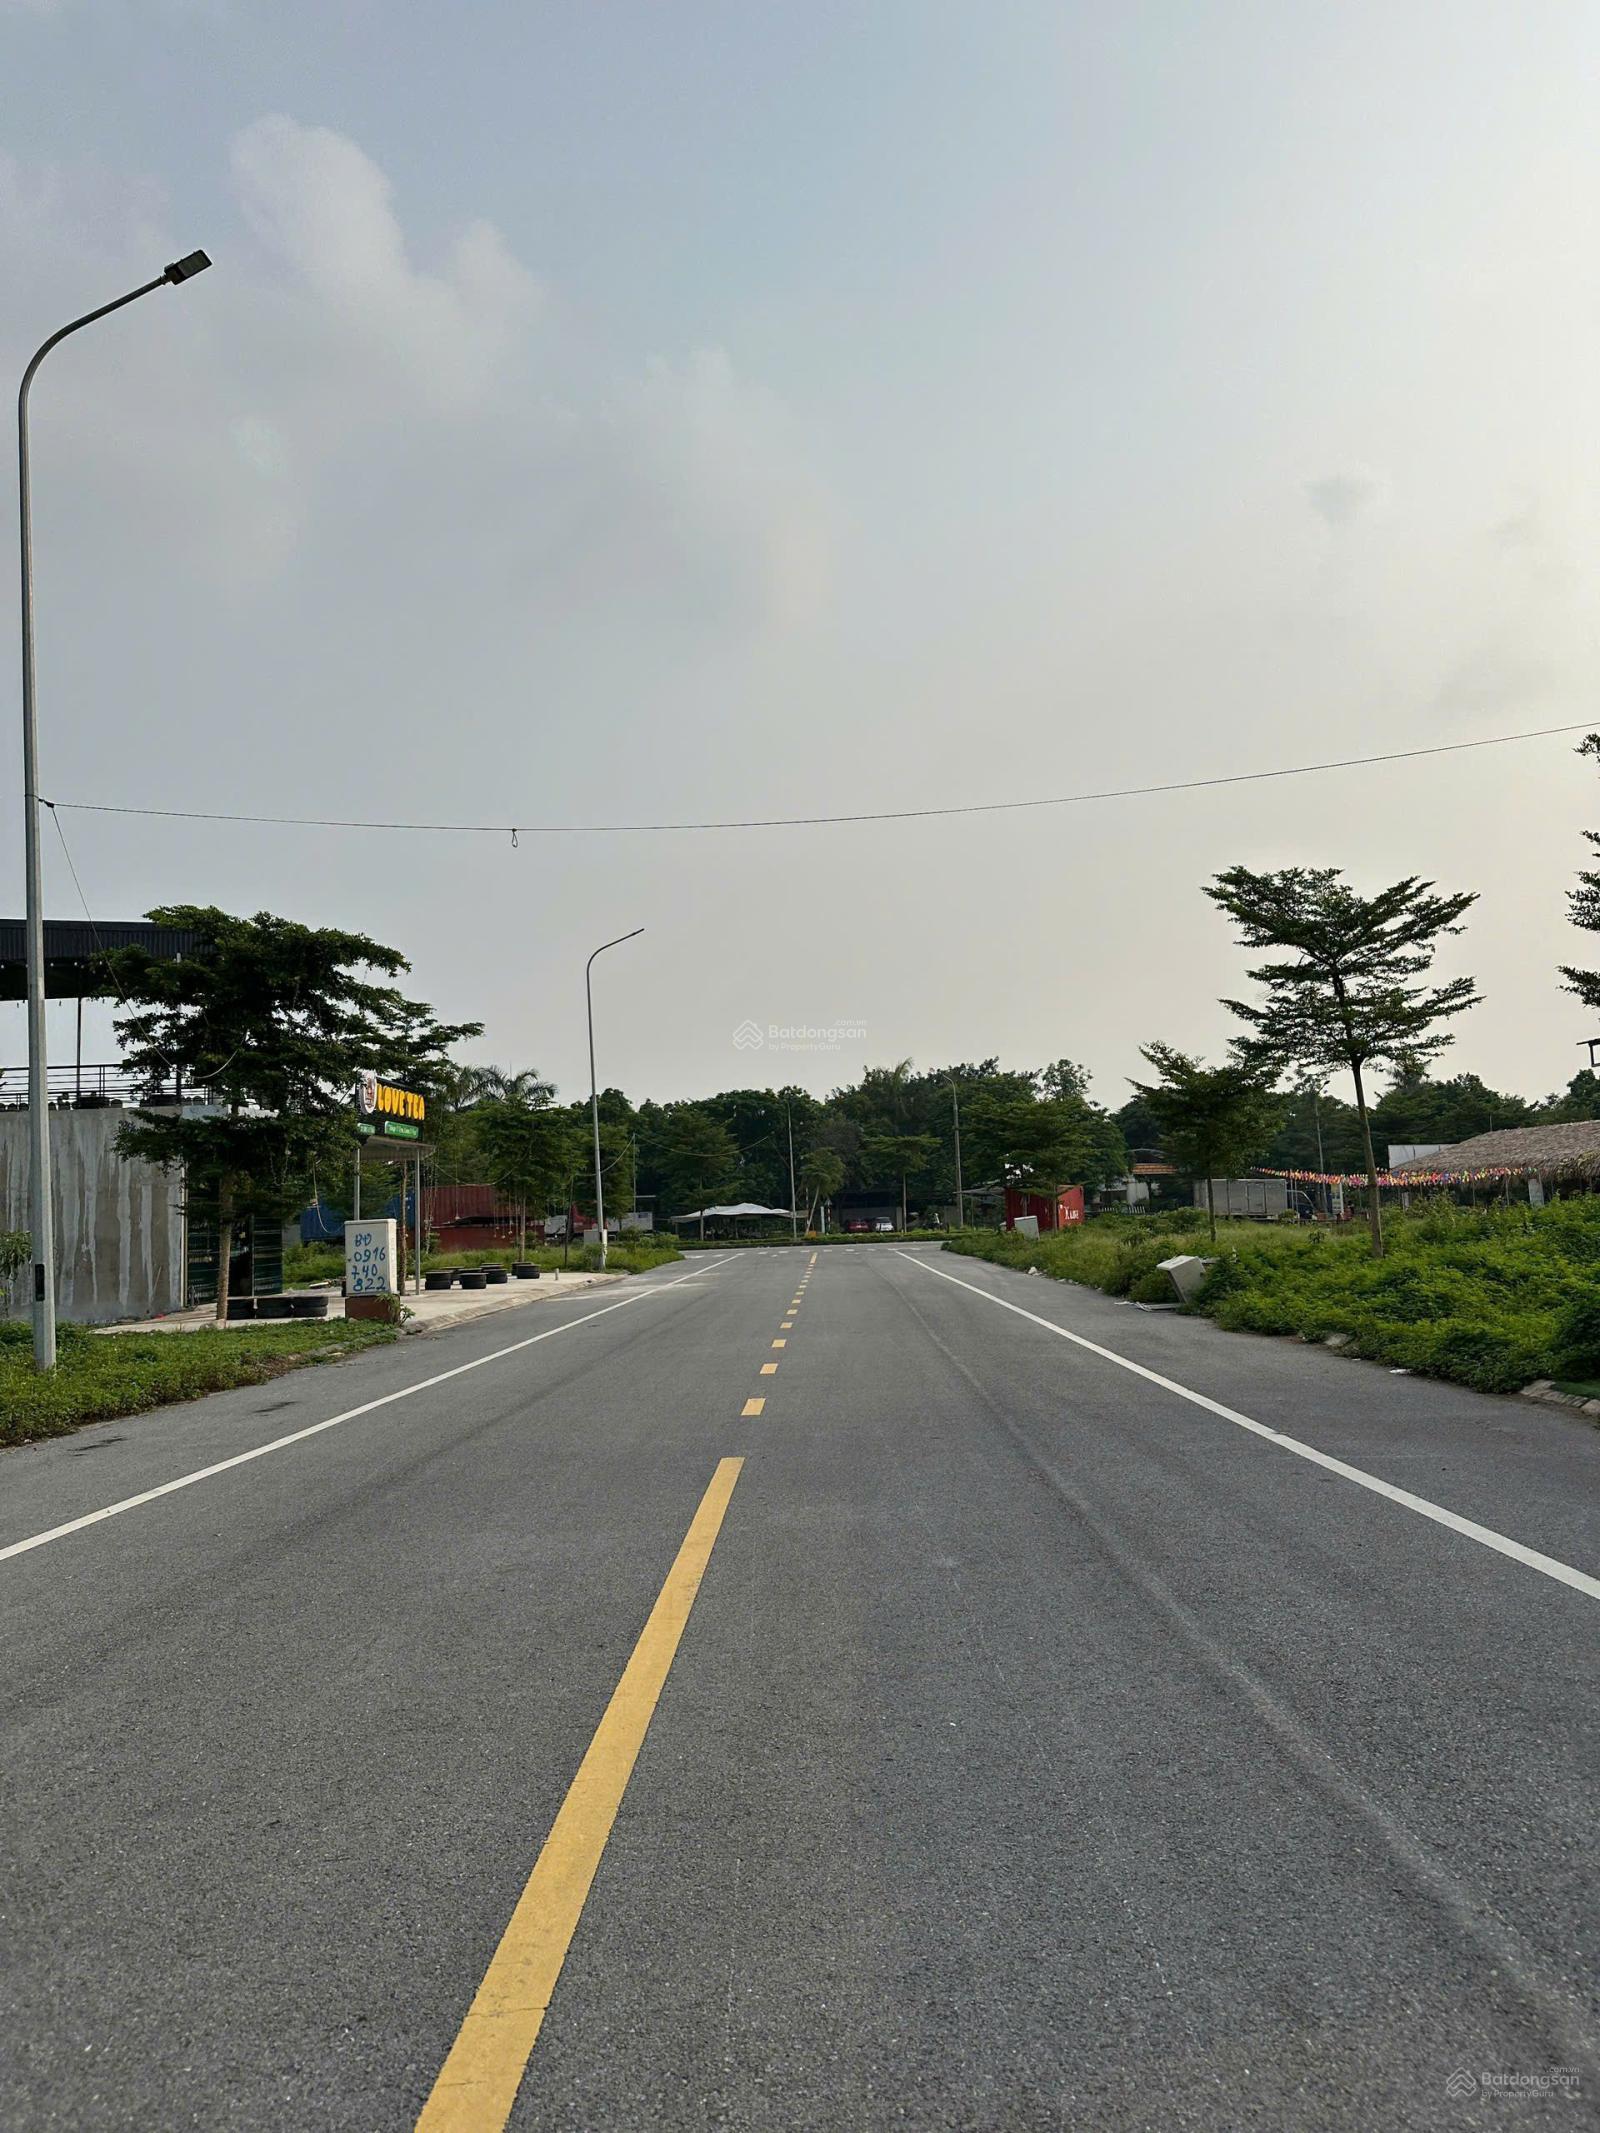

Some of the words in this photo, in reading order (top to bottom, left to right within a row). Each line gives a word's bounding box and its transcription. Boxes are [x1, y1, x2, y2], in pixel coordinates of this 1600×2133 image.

[377, 1083, 405, 1116] LOVE
[405, 1091, 425, 1120] TEA
[351, 1264, 378, 1280] 740
[353, 1276, 386, 1292] 822
